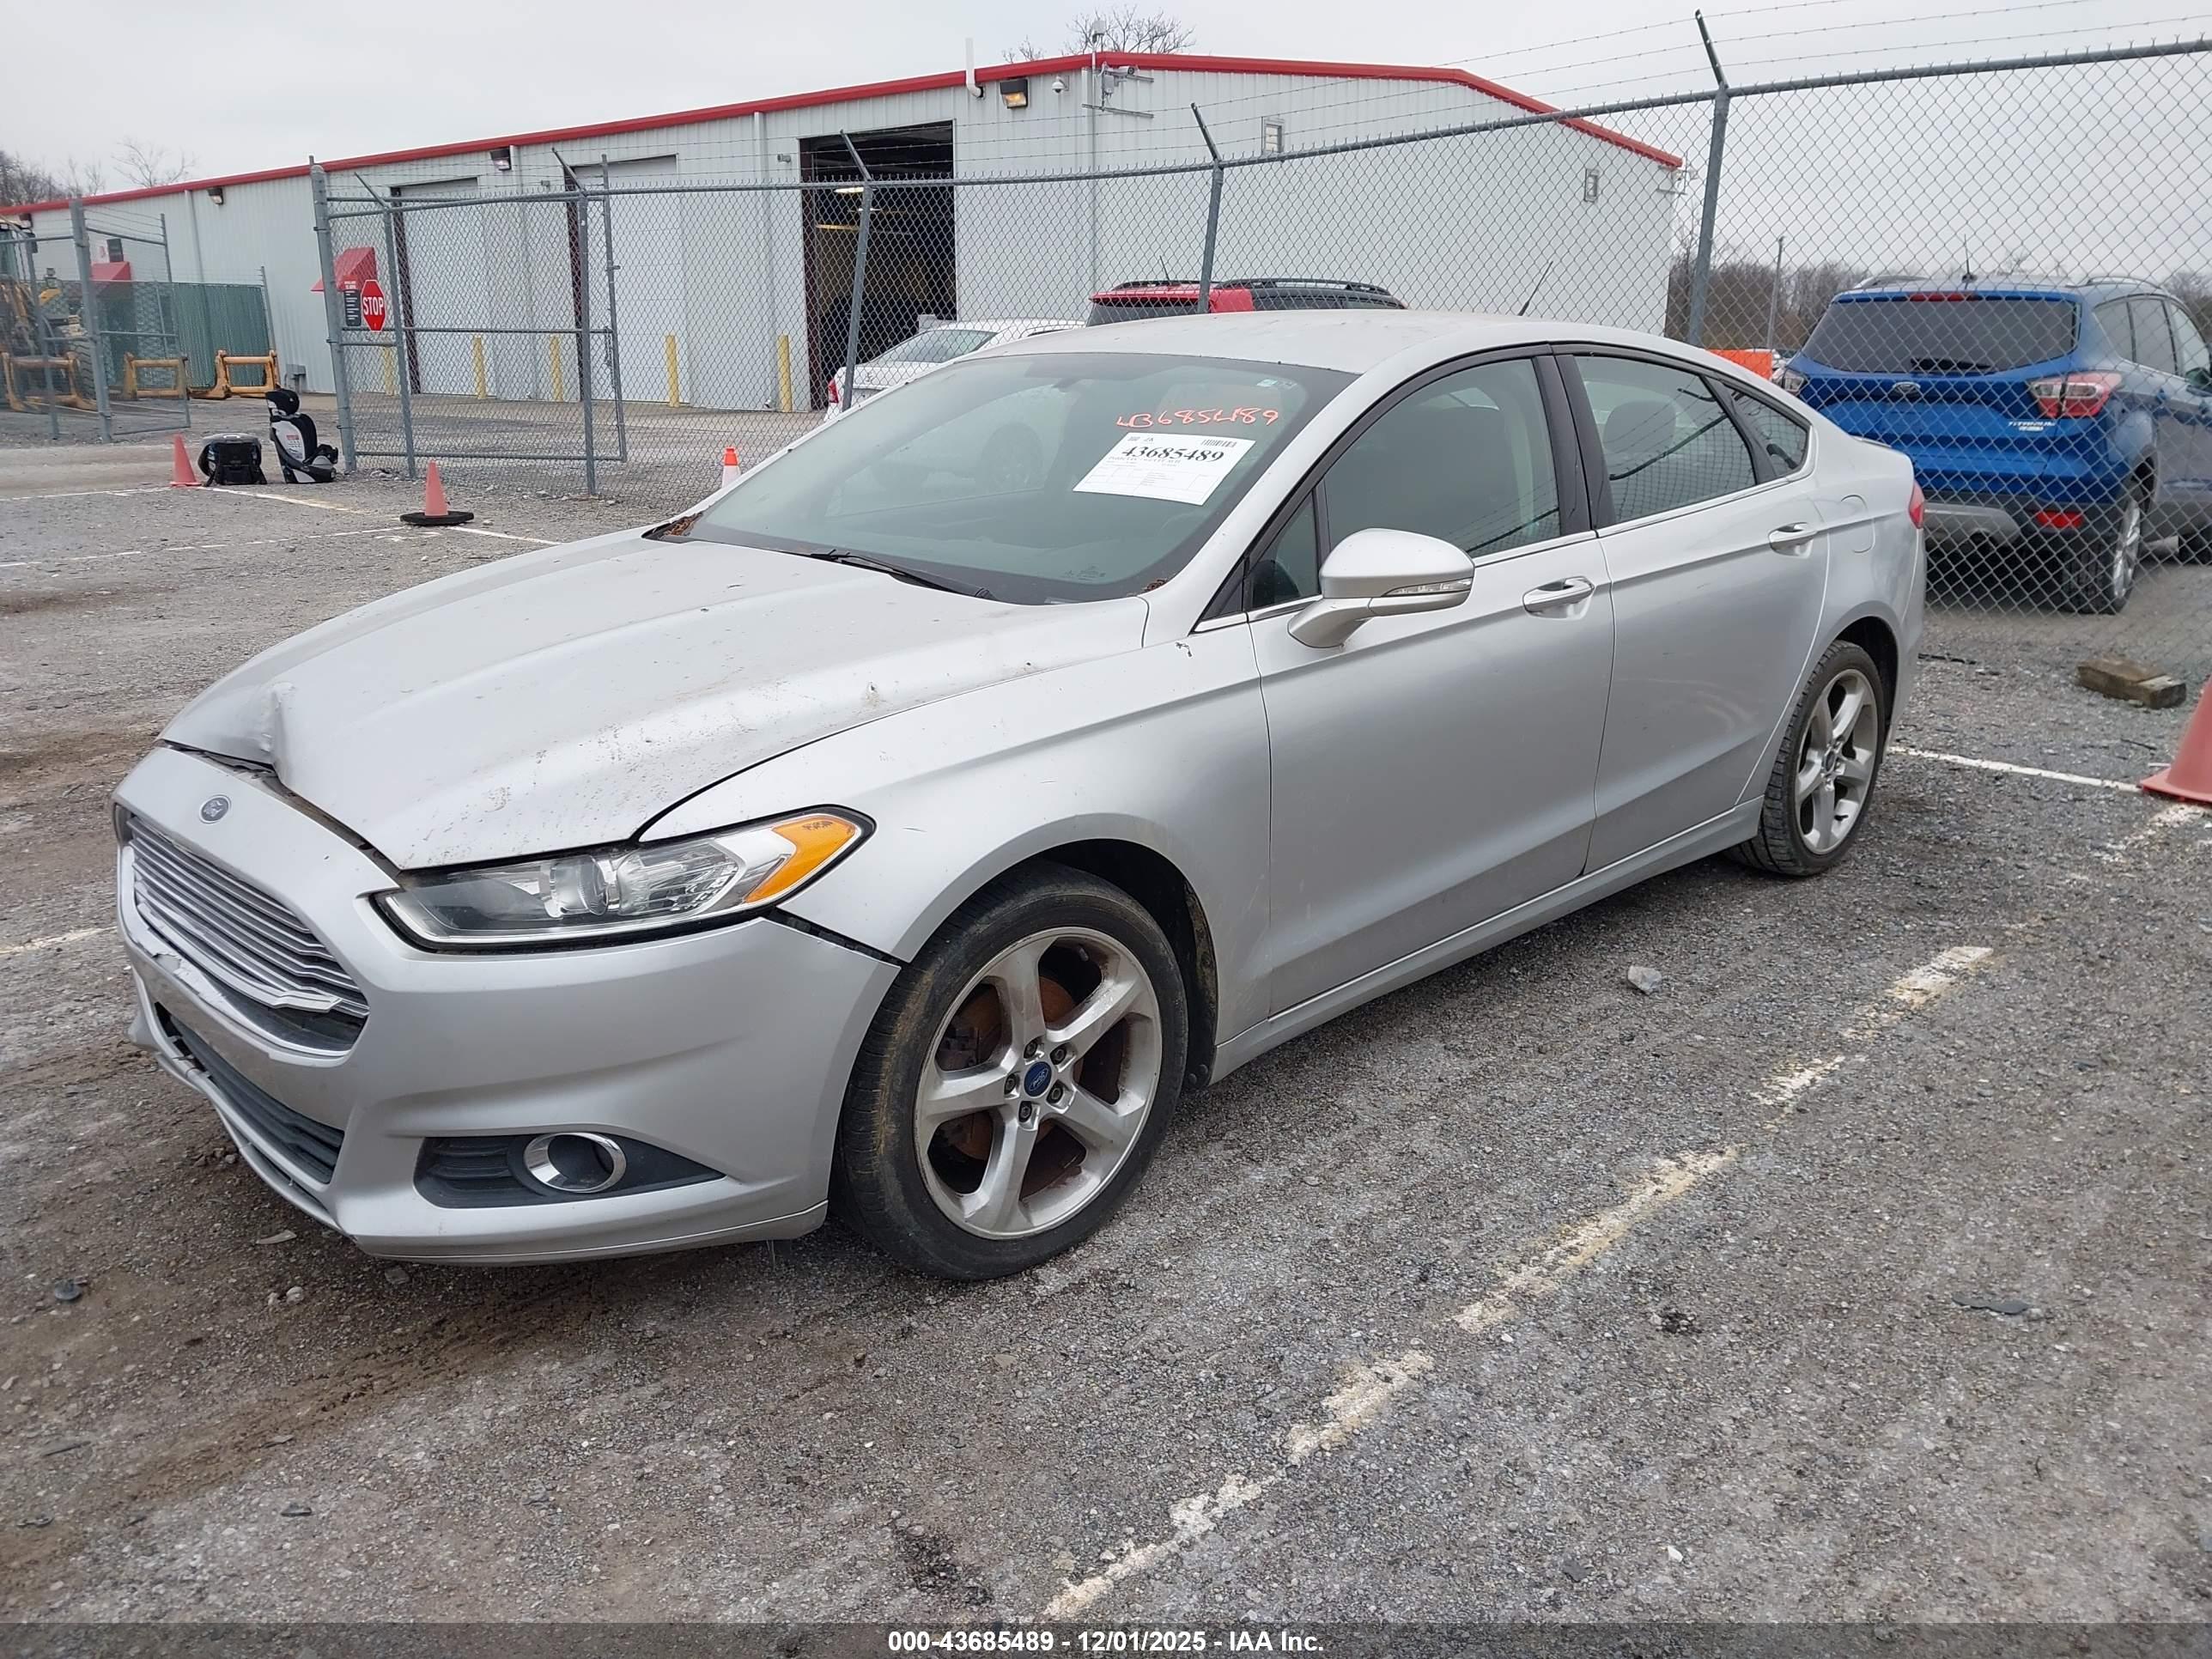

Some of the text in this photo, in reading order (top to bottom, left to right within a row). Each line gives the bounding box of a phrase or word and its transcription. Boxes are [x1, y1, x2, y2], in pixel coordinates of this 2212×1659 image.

[362, 296, 384, 315] STOP
[1116, 406, 1279, 428] 43685489
[1122, 446, 1224, 463] 43685489
